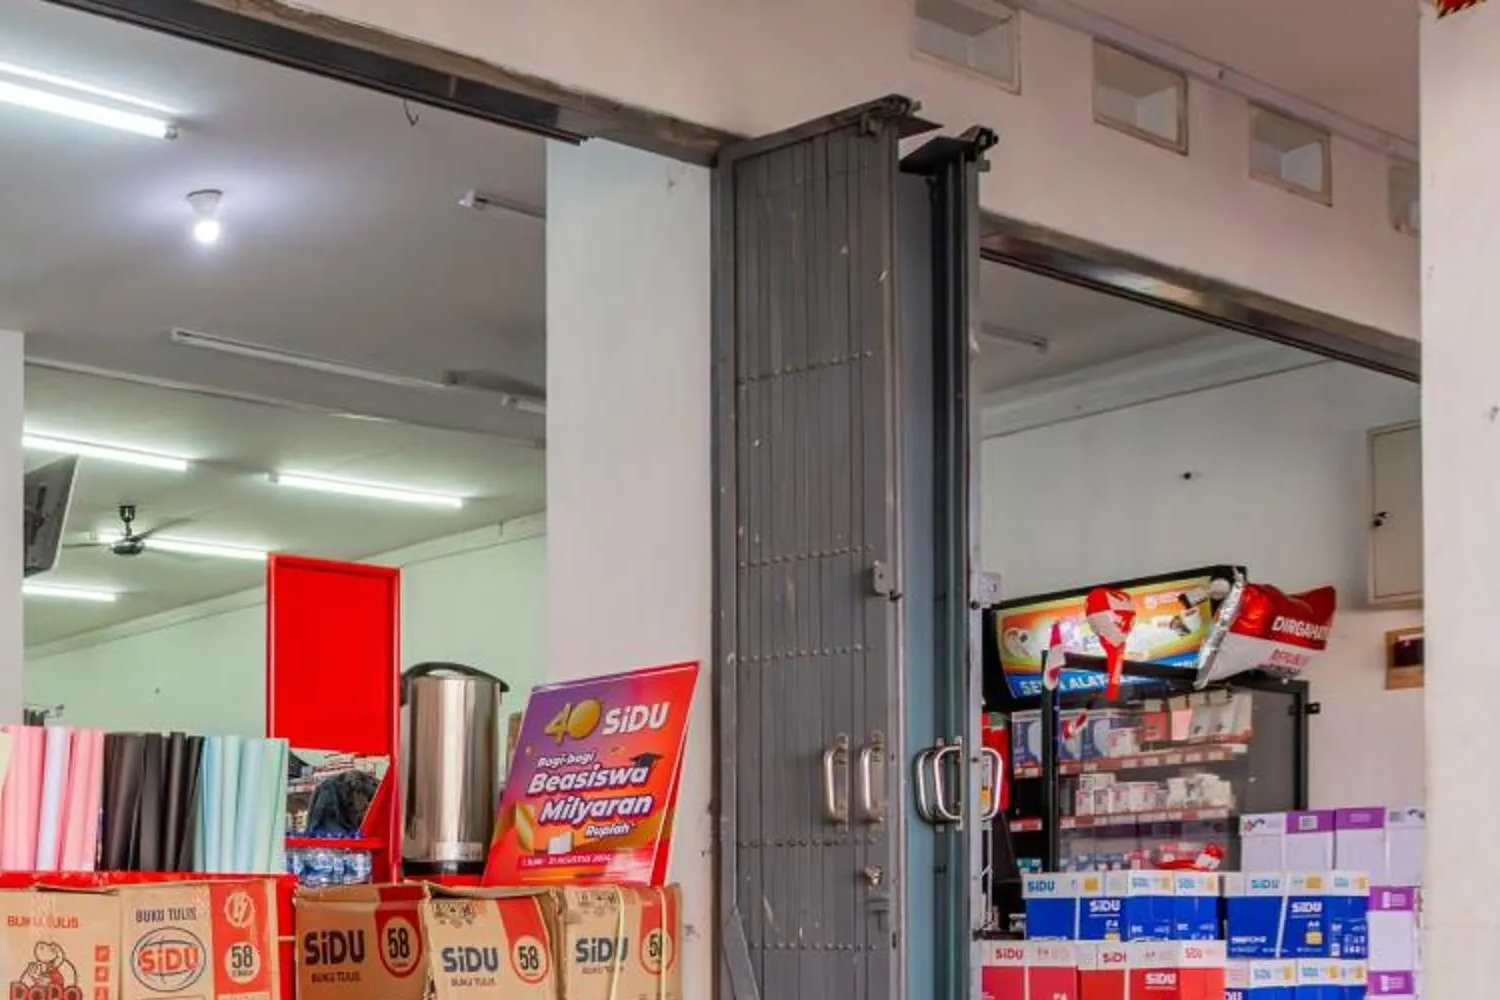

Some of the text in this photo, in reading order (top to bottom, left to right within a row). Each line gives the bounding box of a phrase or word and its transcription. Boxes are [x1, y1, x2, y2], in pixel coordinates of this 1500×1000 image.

[545, 698, 670, 745] 40 SiDU
[527, 763, 649, 795] Beasiswa
[539, 795, 653, 825] Milyaran
[1027, 880, 1056, 892] SiDU
[136, 908, 165, 923] BUKU
[1089, 900, 1120, 912] SiDU
[304, 929, 366, 966] SiDU
[387, 927, 410, 958] 58
[575, 936, 629, 963] SiDU
[995, 947, 1023, 960] SiDU
[139, 946, 199, 974] SiDU
[231, 945, 253, 969] 58
[441, 947, 500, 973] SiDU
[518, 945, 540, 971] 58
